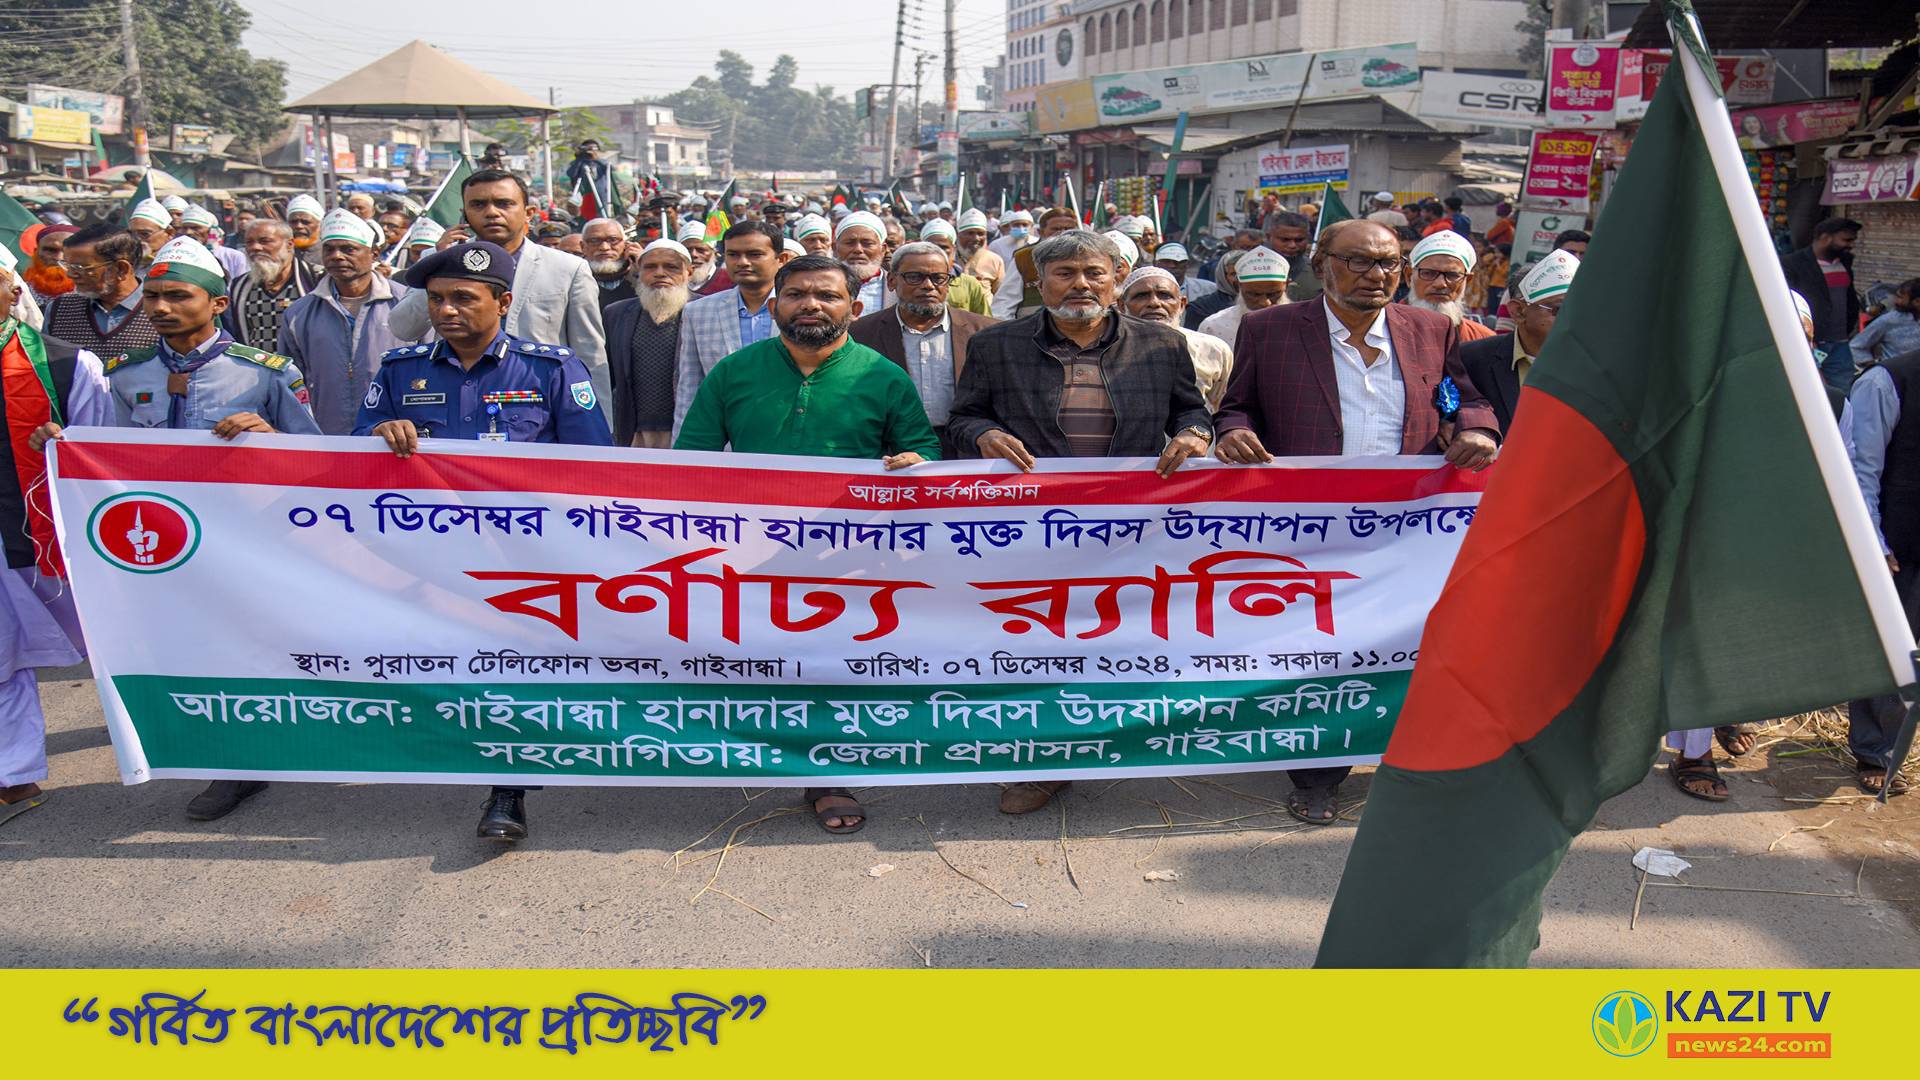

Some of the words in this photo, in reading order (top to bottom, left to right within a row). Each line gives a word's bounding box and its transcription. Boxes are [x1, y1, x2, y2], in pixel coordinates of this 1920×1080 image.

[1459, 91, 1541, 113] CSR
[848, 484, 918, 504] আল্লাহ
[925, 480, 1041, 500] সর্বশক্তিমান
[288, 503, 355, 534] ০৭
[369, 493, 551, 537] ডিসেম্বর
[565, 502, 748, 545] গাইবান্ধা
[760, 515, 934, 552] হানাদার
[943, 519, 1028, 559] মুক্ত
[1037, 508, 1152, 549] দিবস
[464, 547, 936, 645] বর্ণাঢ্য
[290, 652, 350, 674] স্থান:
[363, 653, 458, 680] পুরাতন
[468, 648, 593, 675] টেলিফোন
[599, 656, 669, 680] ভবন,
[844, 651, 930, 678] তারিখ:
[943, 657, 981, 676] ০৭
[990, 650, 1088, 676] ডিসেম্বর
[1096, 655, 1181, 678] ২০২৪,
[1190, 654, 1258, 673] সময়:
[1268, 650, 1341, 671] সকাল
[169, 690, 413, 727] আয়োজনে:
[435, 690, 626, 733] গাইবান্ধা
[639, 696, 815, 733] হানাদার
[827, 700, 914, 737] মুক্ত
[925, 691, 1044, 729] দিবস
[1056, 689, 1245, 728] উদযাপন
[1256, 680, 1388, 719] কমিটি,
[475, 734, 783, 769] সহযোগিতায়:
[808, 739, 930, 766] জেলা
[944, 739, 1121, 766] প্রশাসন,
